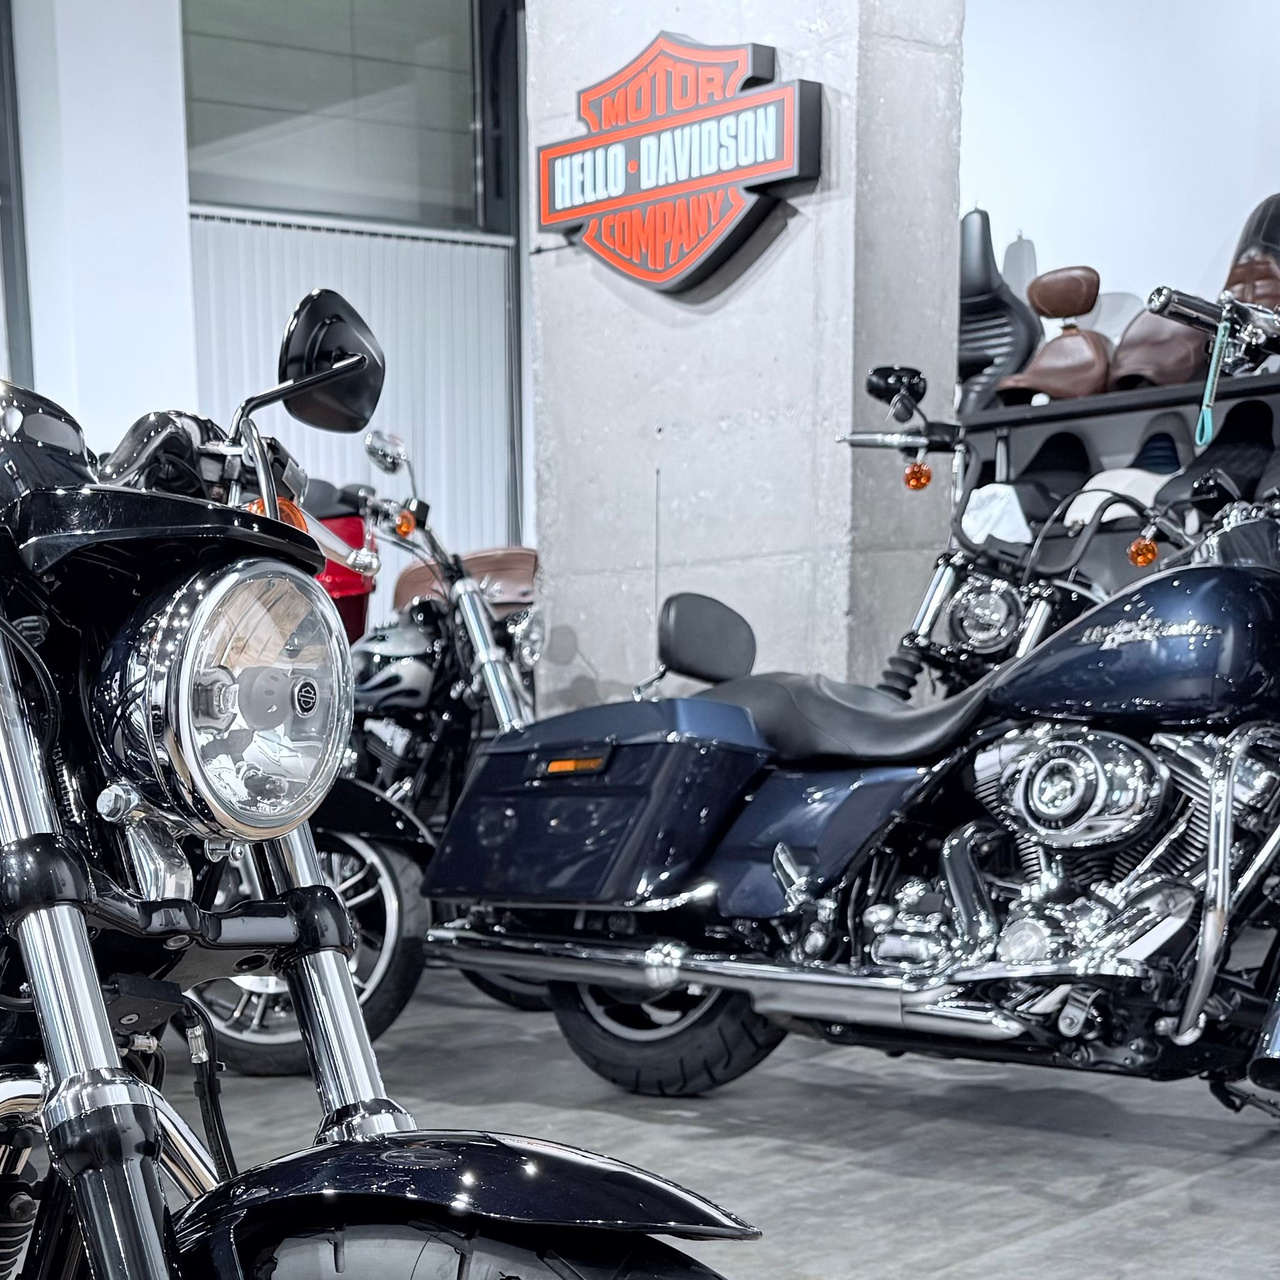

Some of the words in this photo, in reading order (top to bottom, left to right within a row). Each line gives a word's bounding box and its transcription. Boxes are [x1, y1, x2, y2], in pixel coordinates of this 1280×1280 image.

[602, 55, 724, 129] MOTOR
[555, 143, 625, 210] HELLO
[640, 105, 776, 190] DAVIDSON
[602, 189, 725, 270] COMPANY
